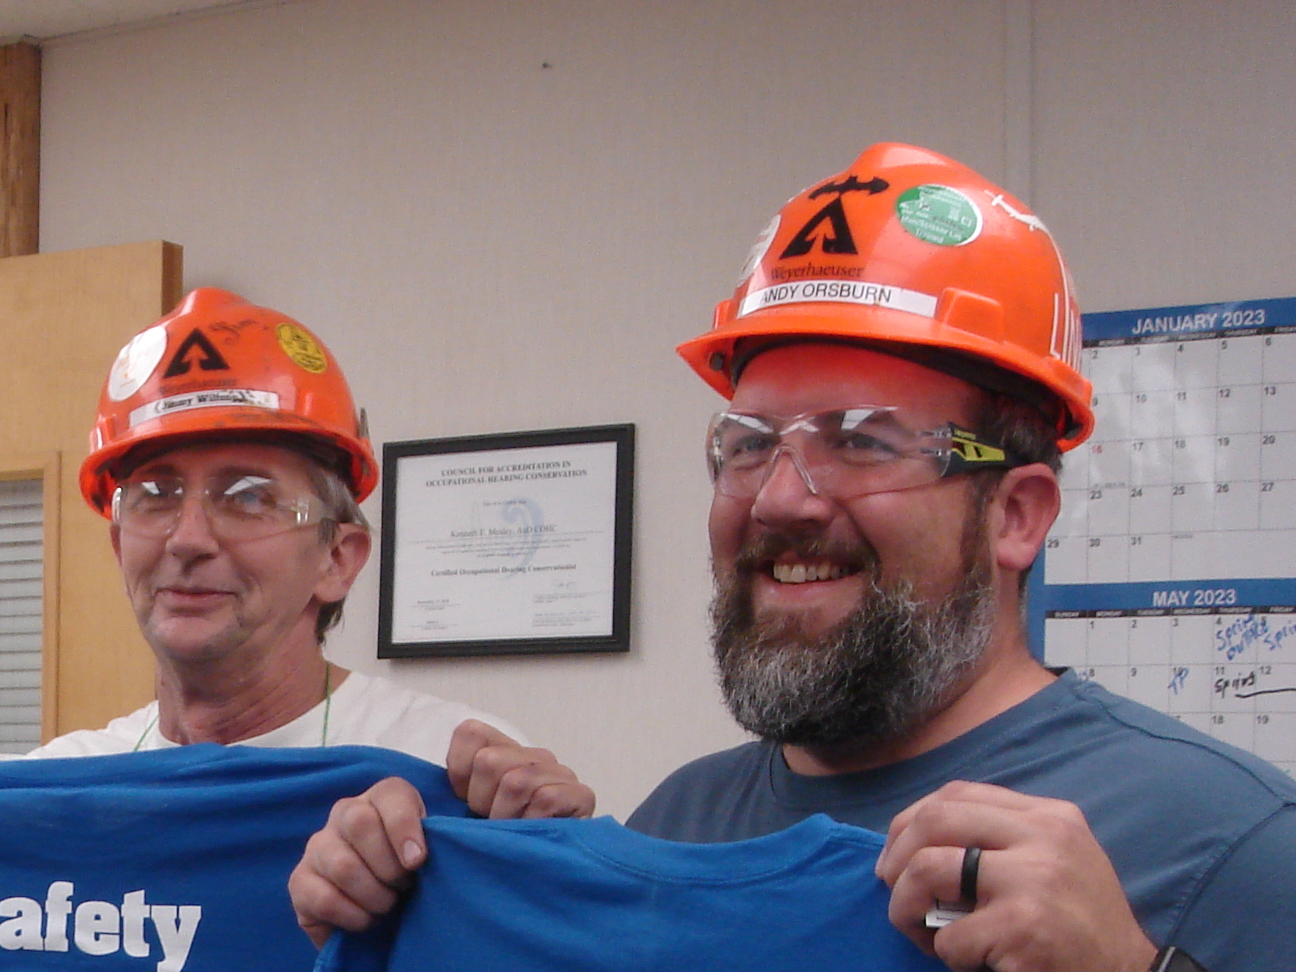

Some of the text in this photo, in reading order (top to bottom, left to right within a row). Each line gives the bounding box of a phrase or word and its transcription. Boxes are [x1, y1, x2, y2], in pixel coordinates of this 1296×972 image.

[771, 262, 864, 282] Weyerhaeuser
[802, 283, 892, 304] ORSBURN
[1131, 312, 1218, 335] JANUARY
[1222, 308, 1266, 328] 2023
[1221, 341, 1228, 350] 5
[1265, 338, 1272, 346] 6
[1177, 344, 1184, 353] 4
[1219, 389, 1231, 398] 12
[1264, 386, 1276, 396] 13
[1136, 394, 1147, 404] 10
[1177, 392, 1187, 401] 11
[1175, 440, 1186, 449] 18
[1218, 437, 1230, 447] 19
[1263, 435, 1276, 445] 20
[1133, 442, 1144, 451] 17
[441, 460, 571, 477] COUNCIL FOR ACCREDITATION IN
[425, 469, 588, 487] OCCUPATIONAL HEARING CONSERVATION
[1172, 486, 1185, 495] 25
[1216, 483, 1229, 493] 26
[1261, 482, 1274, 492] 27
[1090, 490, 1102, 500] 23
[1130, 488, 1143, 498] 24
[1046, 539, 1060, 549] 29
[1089, 538, 1101, 548] 30
[1130, 536, 1142, 546] 31
[1152, 588, 1237, 606] MAY 2023
[1131, 619, 1137, 628] 2
[1172, 618, 1179, 627] 3
[1216, 616, 1222, 625] 4
[1089, 668, 1095, 677] 8
[1131, 668, 1137, 677] 9
[1214, 666, 1225, 675] 11
[1259, 665, 1272, 675] 12
[1212, 715, 1224, 724] 18
[1256, 715, 1269, 725] 19
